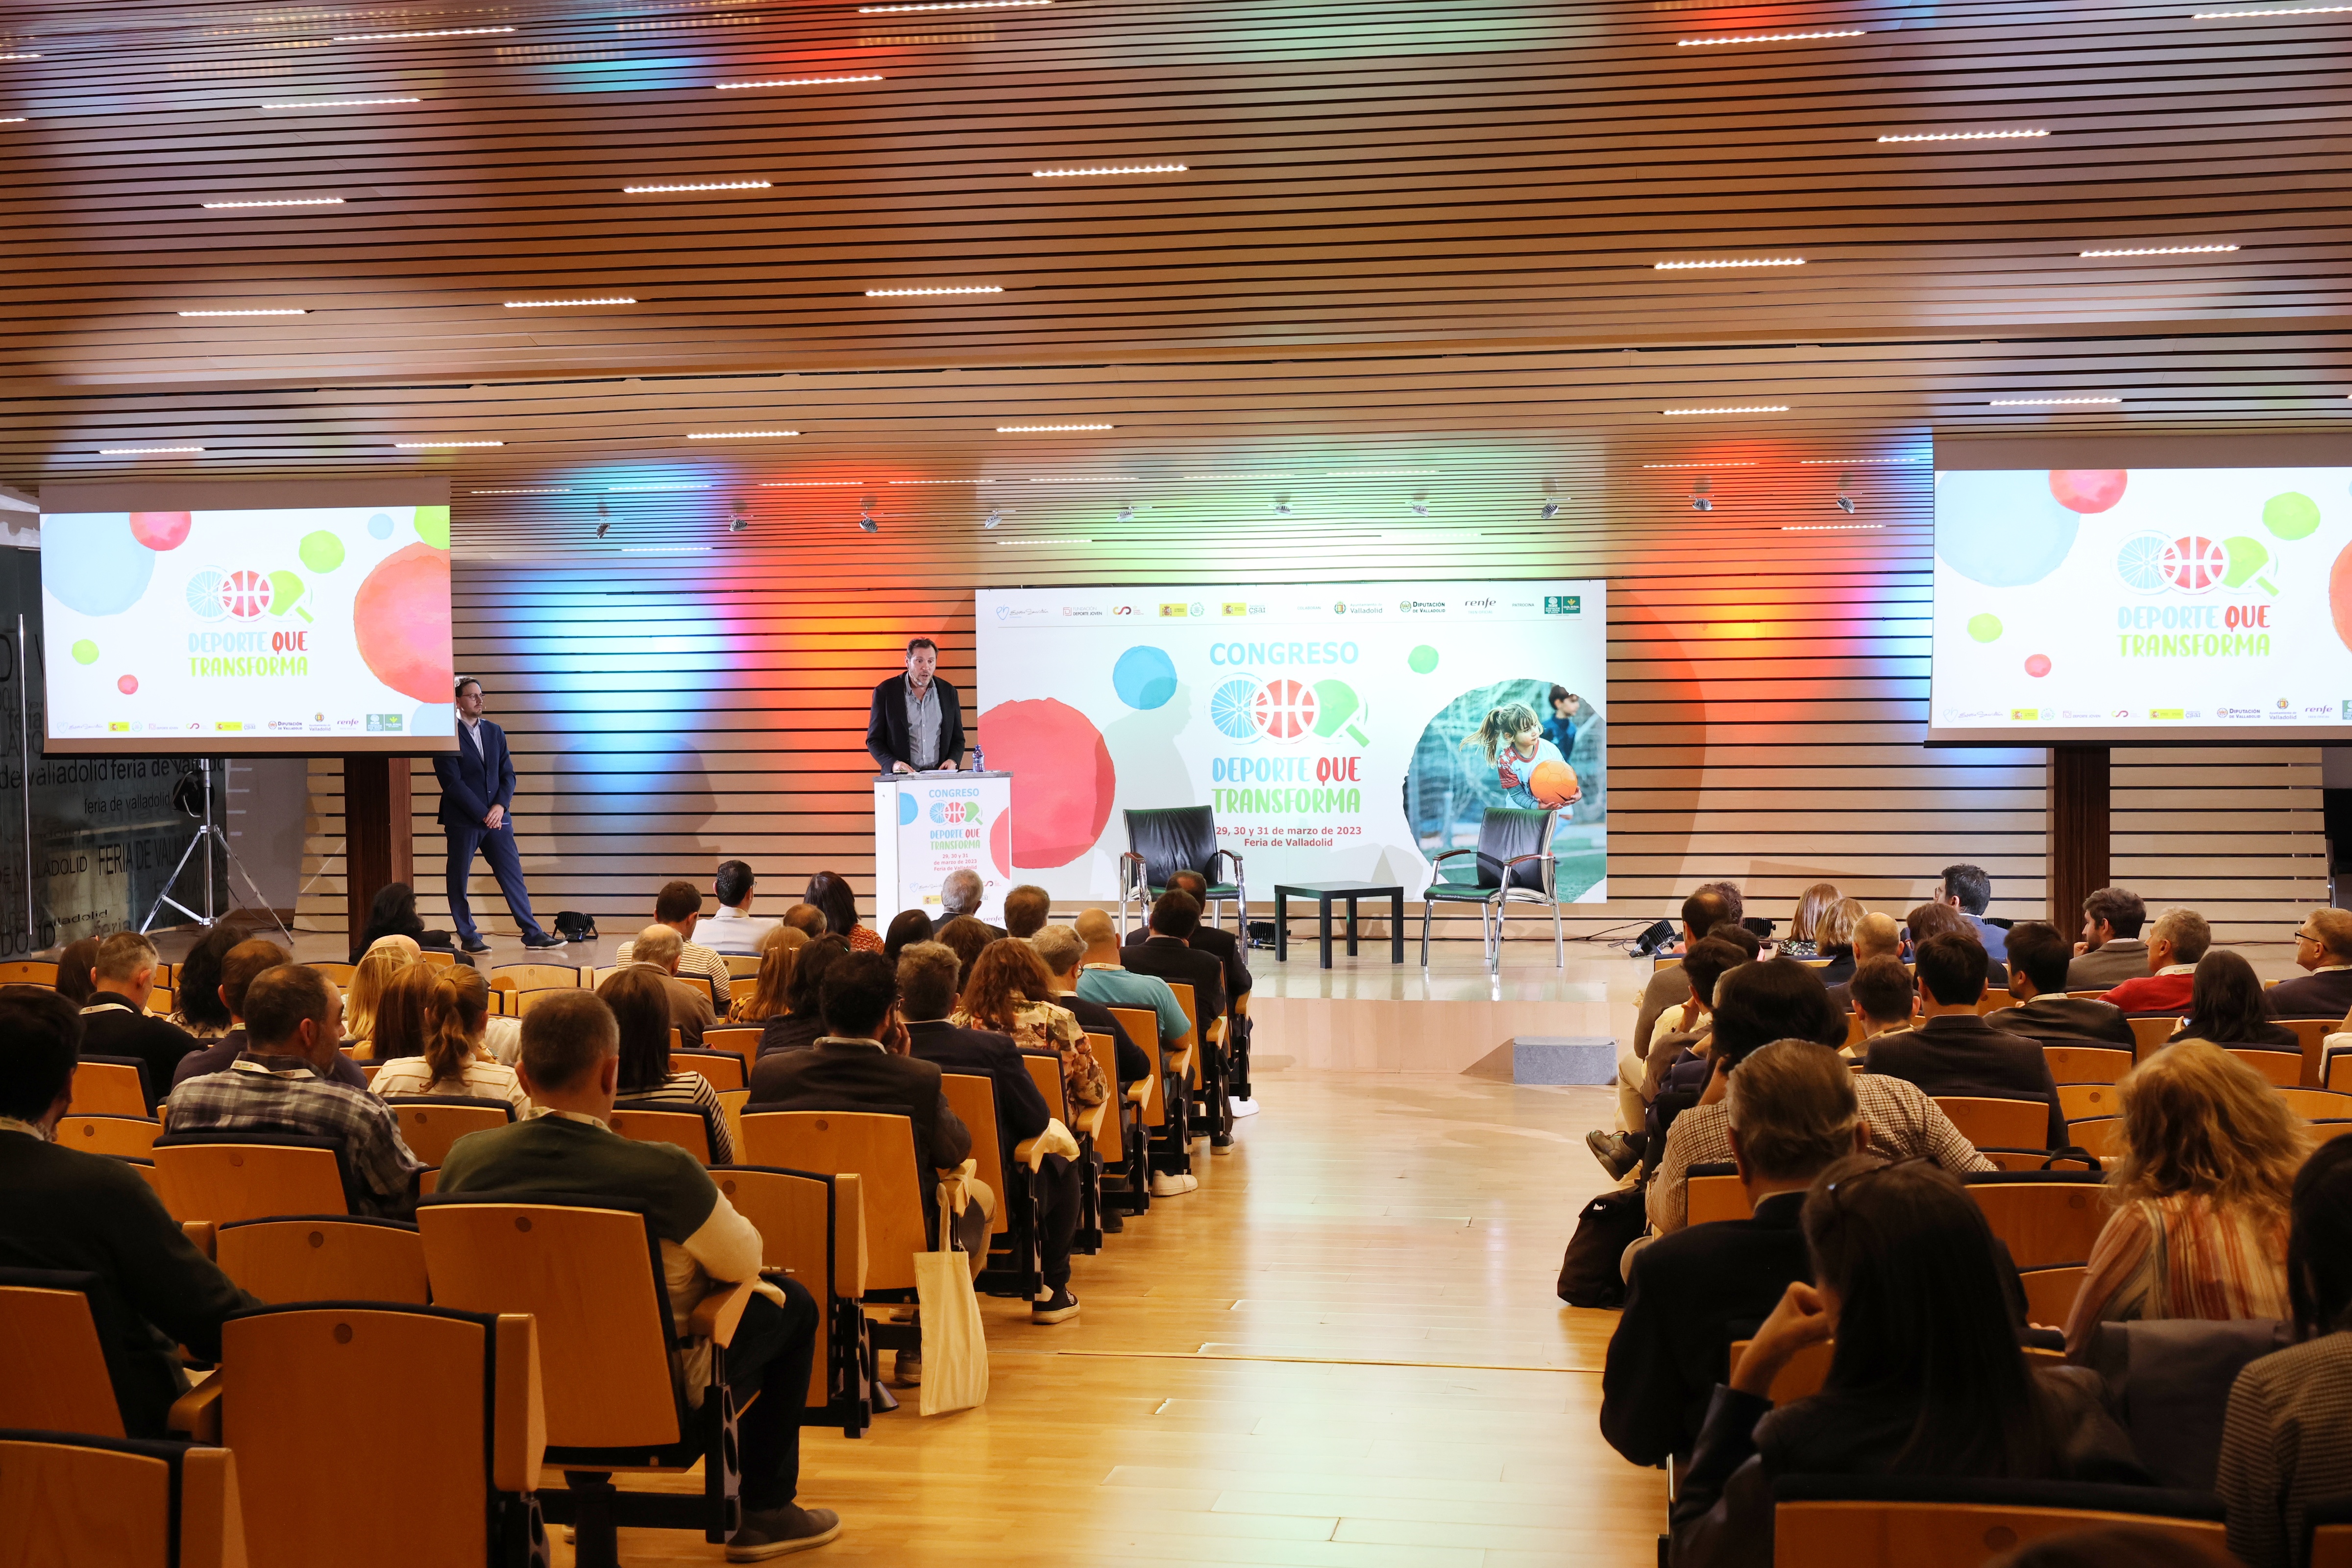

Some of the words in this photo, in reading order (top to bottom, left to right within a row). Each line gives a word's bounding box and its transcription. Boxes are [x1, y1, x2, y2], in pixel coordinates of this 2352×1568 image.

[1465, 597, 1496, 609] renfe
[2117, 606, 2219, 629] DEPORTE
[2225, 605, 2271, 632] QUE
[188, 632, 268, 653] DEPORTE
[272, 631, 308, 655] QUE
[1210, 641, 1359, 665] CONGRESO
[2116, 634, 2270, 657] TRANSFORMA
[188, 656, 308, 677] TRANSFORMA
[2304, 705, 2332, 714] renfe
[337, 718, 359, 727] renfe
[110, 759, 147, 780] feria
[151, 759, 170, 777] de
[1212, 757, 1310, 783] DEPORTE
[1316, 756, 1362, 786] QUE
[84, 797, 107, 814] feria
[110, 796, 122, 811] de
[125, 791, 171, 810] valladolid
[929, 788, 980, 798] CONGRESO
[1211, 788, 1361, 814] TRANSFORMA
[930, 829, 964, 839] DEPORTE
[965, 828, 980, 840] QUE
[1216, 826, 1230, 836] 29,
[1234, 826, 1246, 835] 30
[1249, 828, 1254, 836] y
[1257, 826, 1269, 835] 31
[1272, 826, 1284, 835] de
[1321, 826, 1333, 835] de
[1337, 826, 1362, 835] 2023
[930, 839, 980, 851] TRANSFORMA
[1244, 838, 1268, 847] Feria
[1271, 838, 1283, 847] de
[1285, 838, 1333, 847] Valladolid
[98, 842, 133, 876] FERIA
[136, 839, 152, 871] DE
